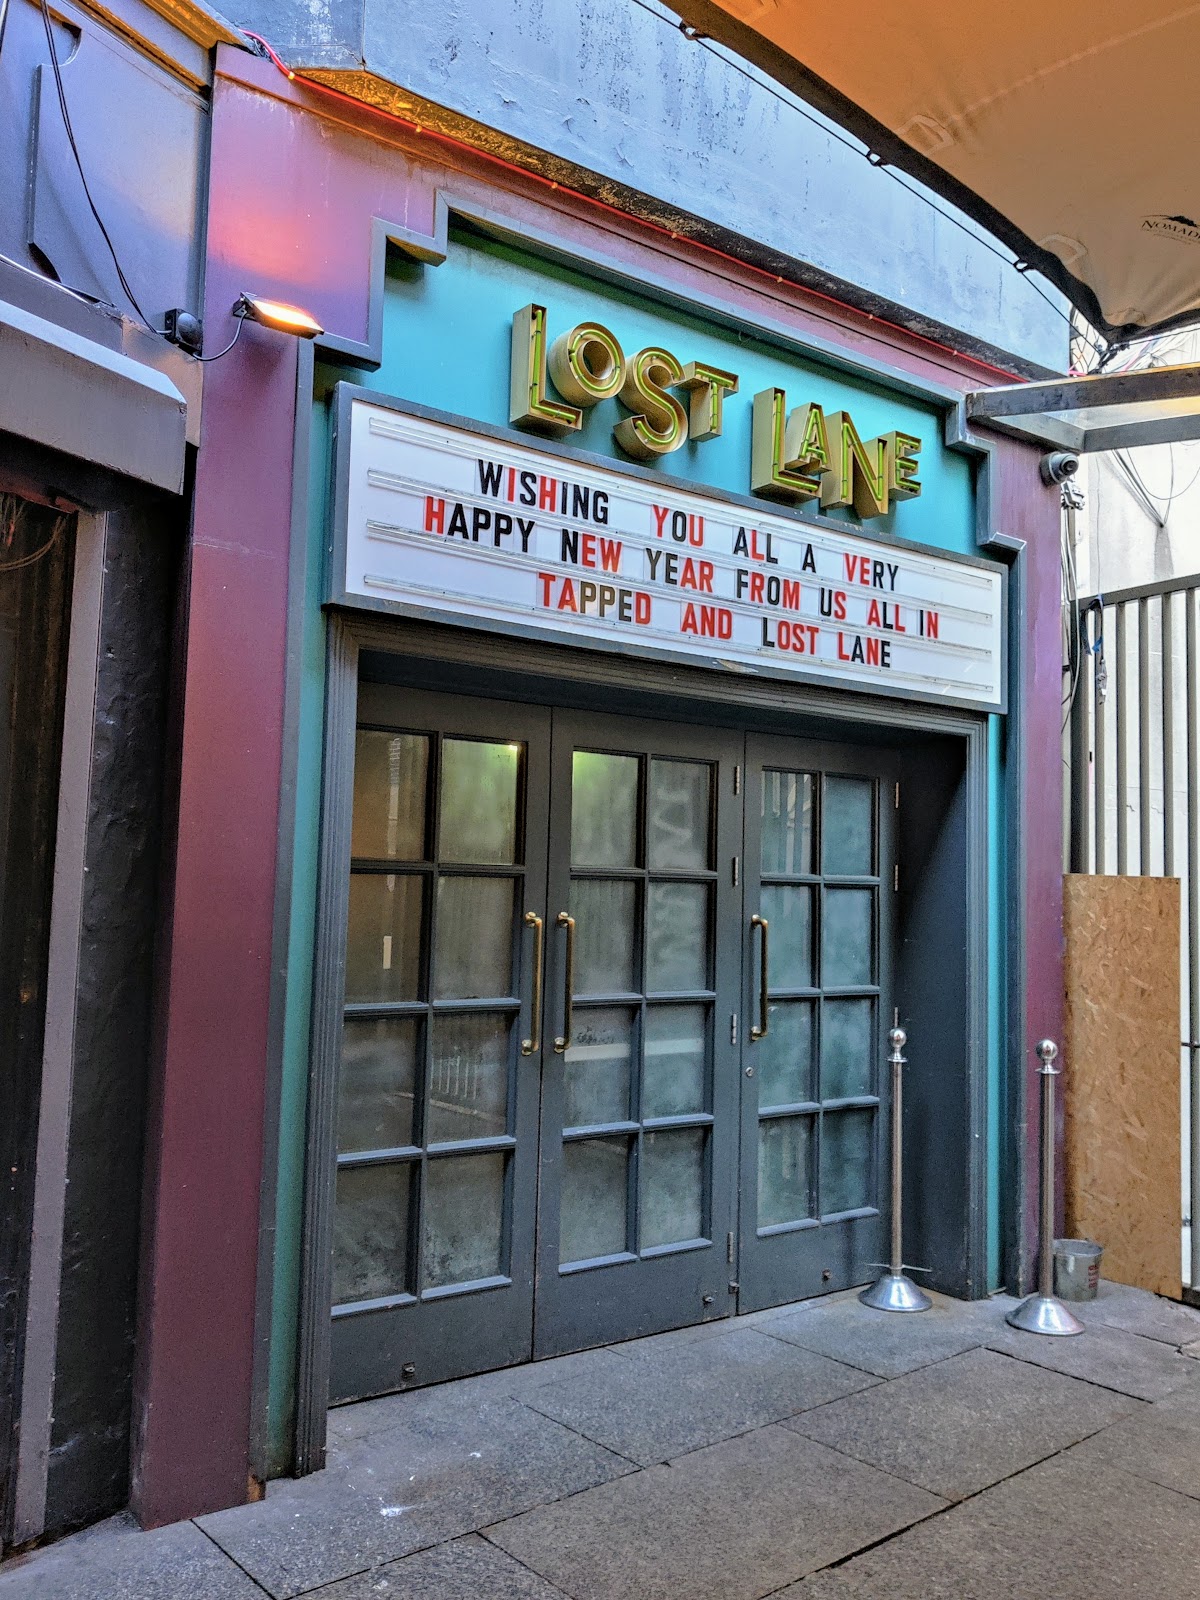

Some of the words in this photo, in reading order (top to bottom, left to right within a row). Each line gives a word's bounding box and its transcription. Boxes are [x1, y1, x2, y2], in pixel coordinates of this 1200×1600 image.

[1141, 220, 1200, 239] NOMAD
[510, 303, 739, 460] LOST
[751, 387, 921, 519] LANE
[424, 496, 535, 553] HAPPY
[561, 528, 622, 573] NEW
[645, 547, 714, 593] YEAR
[736, 568, 801, 611] FROM
[820, 586, 847, 620] US
[867, 599, 906, 633] ALL
[919, 609, 939, 639] IN
[477, 459, 609, 525] WISHING
[652, 504, 704, 547] YOU
[733, 526, 778, 564] ALL
[802, 543, 816, 574] A
[844, 552, 899, 591] VERY
[538, 572, 651, 625] TAPPED
[681, 602, 732, 640] AND
[762, 617, 819, 655] LOST
[838, 631, 891, 668] LANE
